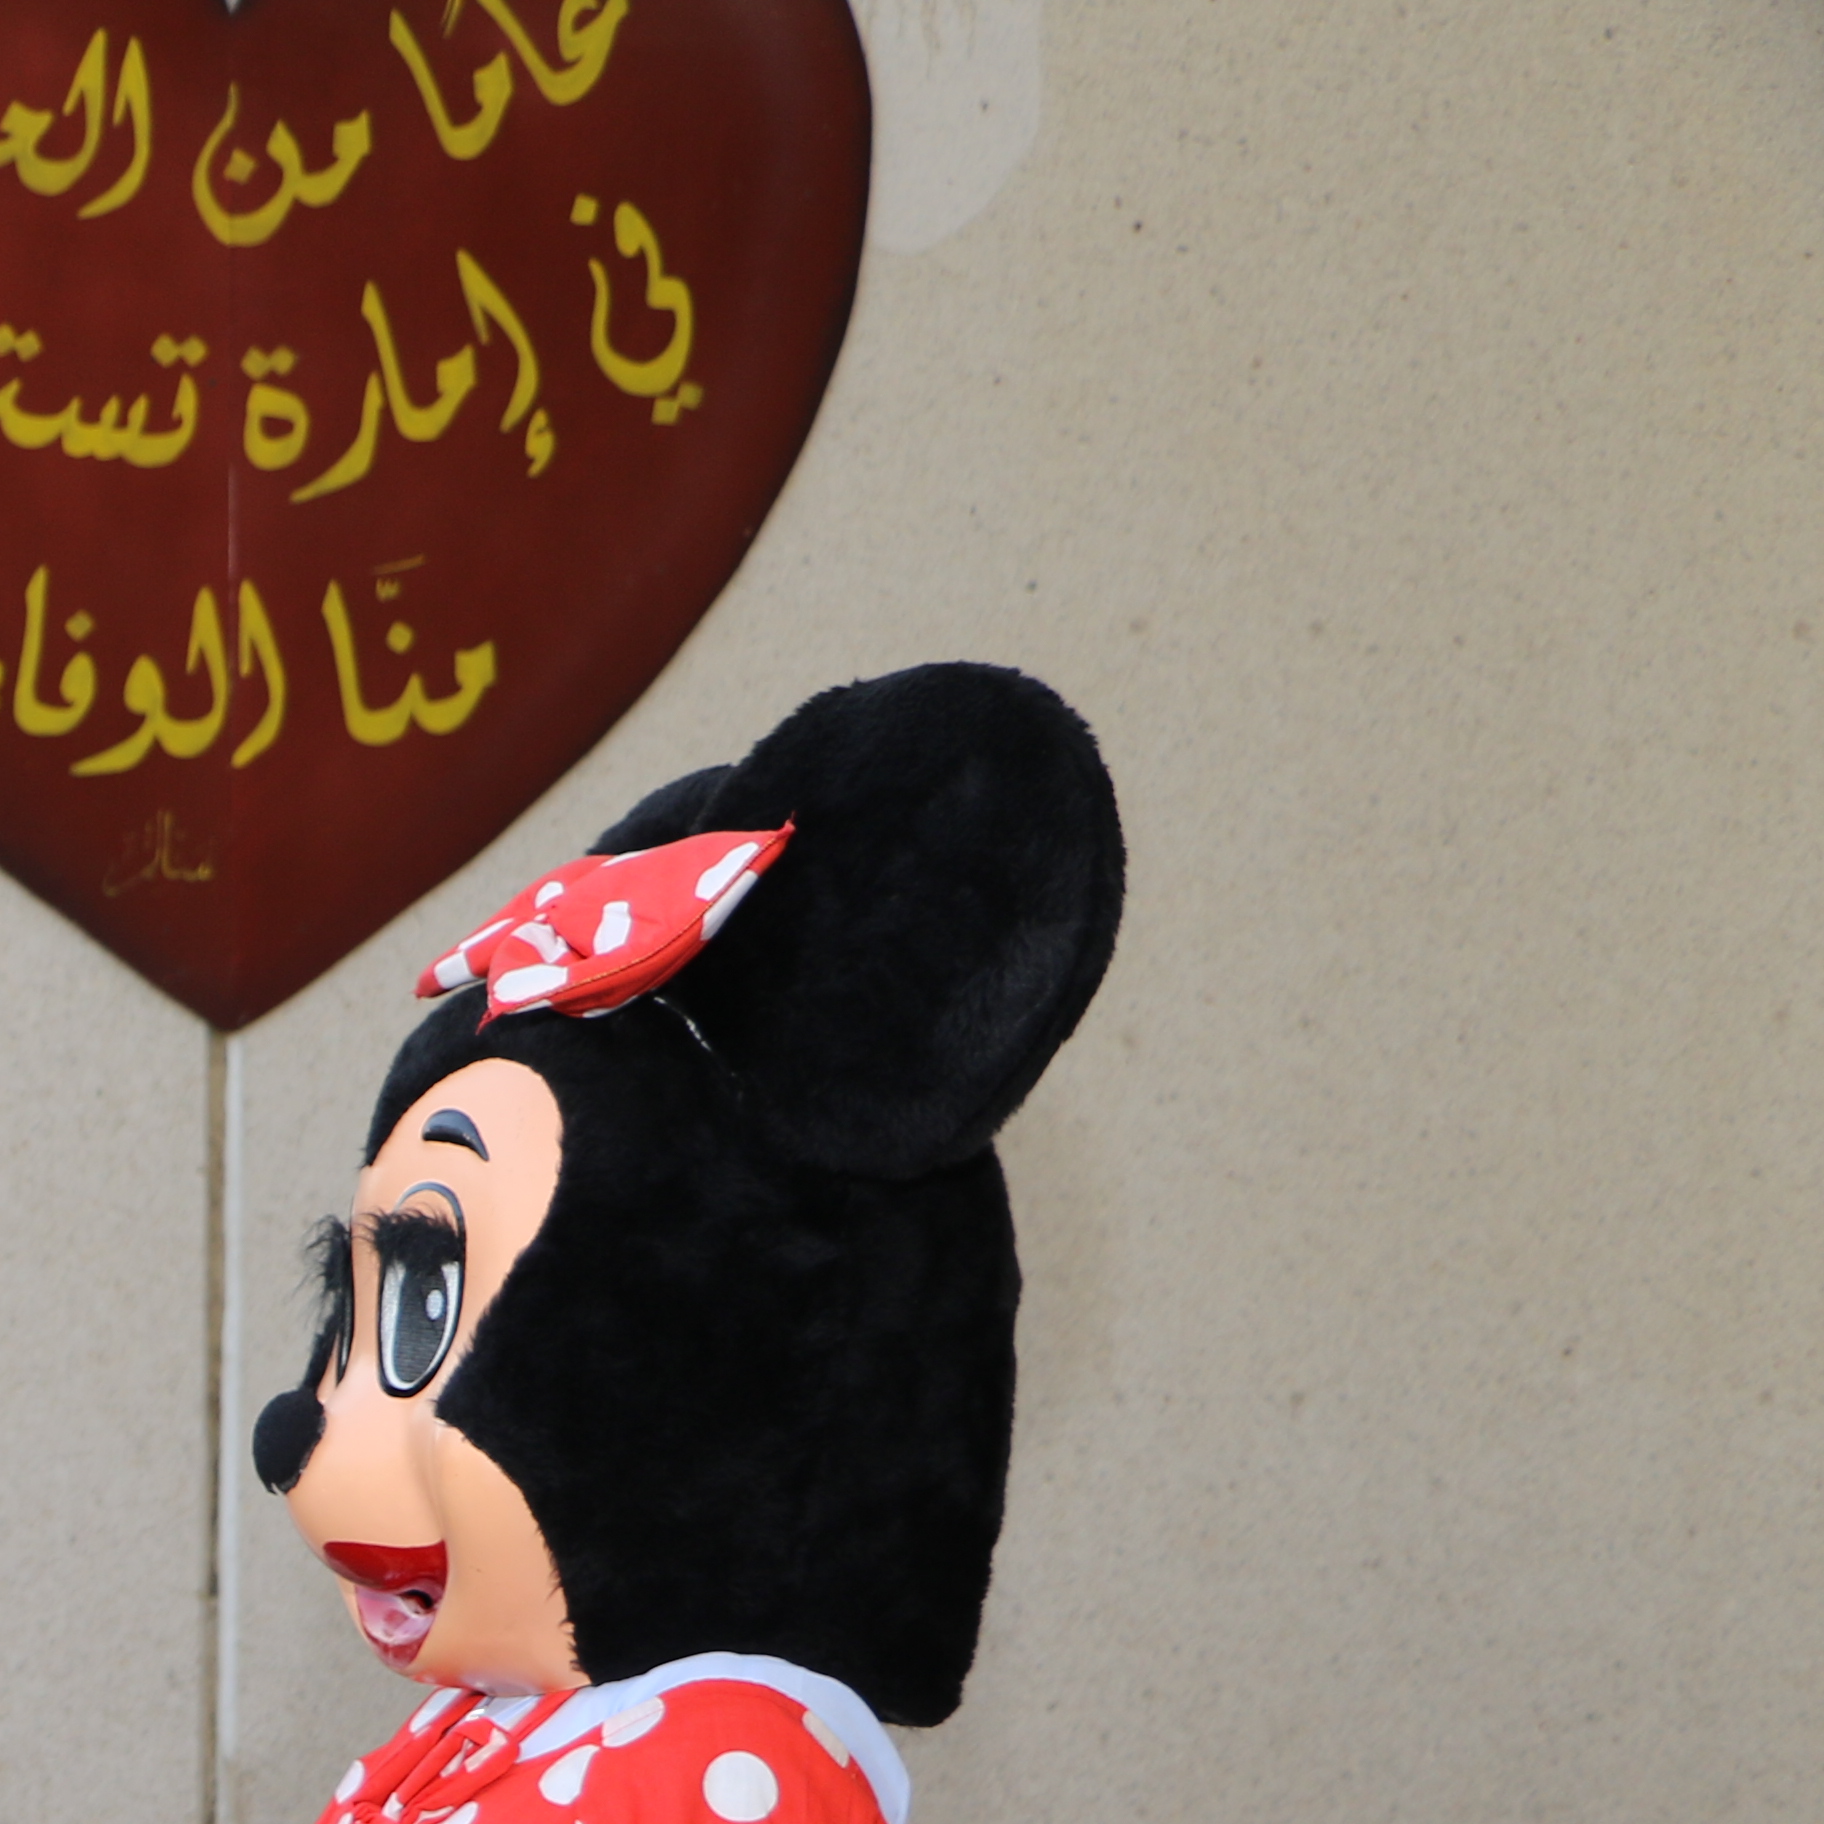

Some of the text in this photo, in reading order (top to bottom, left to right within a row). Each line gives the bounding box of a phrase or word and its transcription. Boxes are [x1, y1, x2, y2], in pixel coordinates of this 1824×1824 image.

[192, 80, 372, 247] من
[241, 247, 555, 504] إمارة
[570, 194, 703, 426] في
